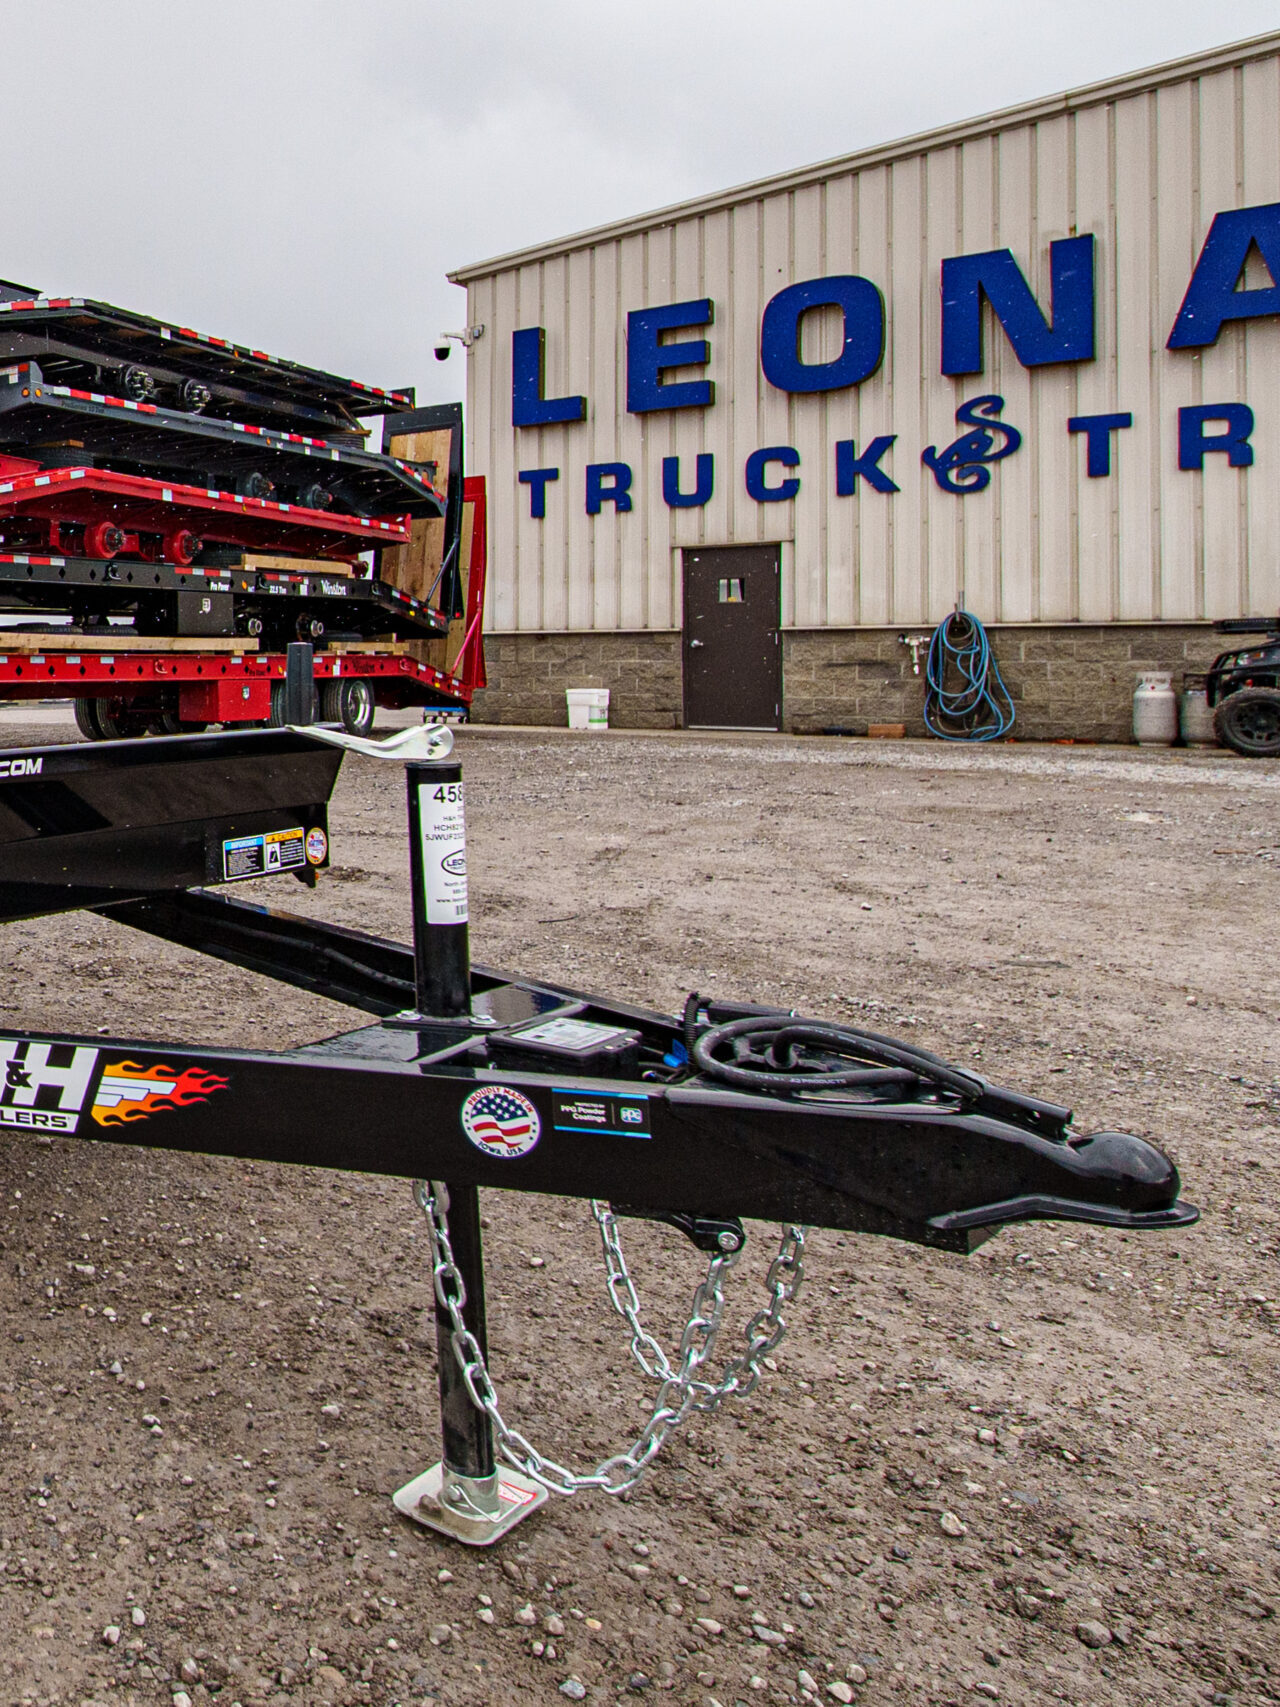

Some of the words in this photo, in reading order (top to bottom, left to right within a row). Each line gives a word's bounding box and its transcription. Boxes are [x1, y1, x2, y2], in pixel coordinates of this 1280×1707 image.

[512, 202, 1280, 427] LEONA
[519, 435, 901, 518] TRUCK
[921, 395, 1022, 494] &
[1067, 403, 1255, 478] TR
[321, 580, 347, 596] Winston
[467, 1087, 501, 1107] PROUDLY
[572, 1113, 607, 1124] Coatings
[578, 1106, 606, 1116] Powder
[507, 1146, 525, 1157] USA
